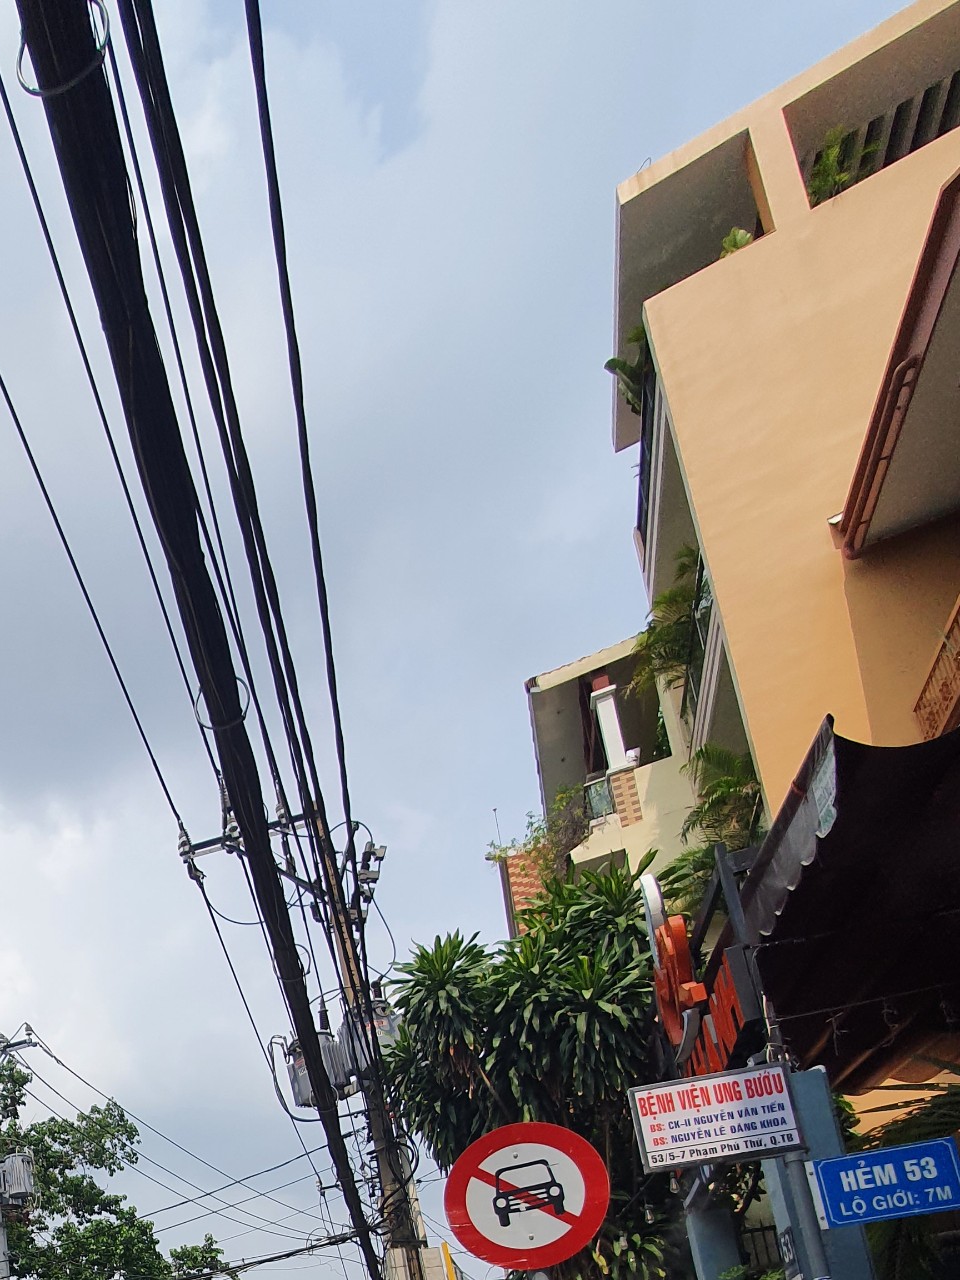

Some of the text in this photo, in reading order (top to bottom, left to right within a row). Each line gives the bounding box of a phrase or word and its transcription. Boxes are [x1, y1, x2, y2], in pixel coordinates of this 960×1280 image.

[638, 1069, 784, 1120] BỆNH VIỆN UNG BƯỚU
[650, 1123, 665, 1132] BS:
[694, 1109, 735, 1126] NGUYỄN
[652, 1137, 668, 1147] BS:
[670, 1128, 711, 1144] NGUYỄN
[760, 1116, 787, 1129] KHOA
[651, 1151, 686, 1164] 53/5-7
[689, 1146, 718, 1158] Phạm
[770, 1133, 794, 1145] Q.TB
[839, 1156, 938, 1193] HẺM 53
[839, 1185, 953, 1217] LỘ GIỚI: 7M
